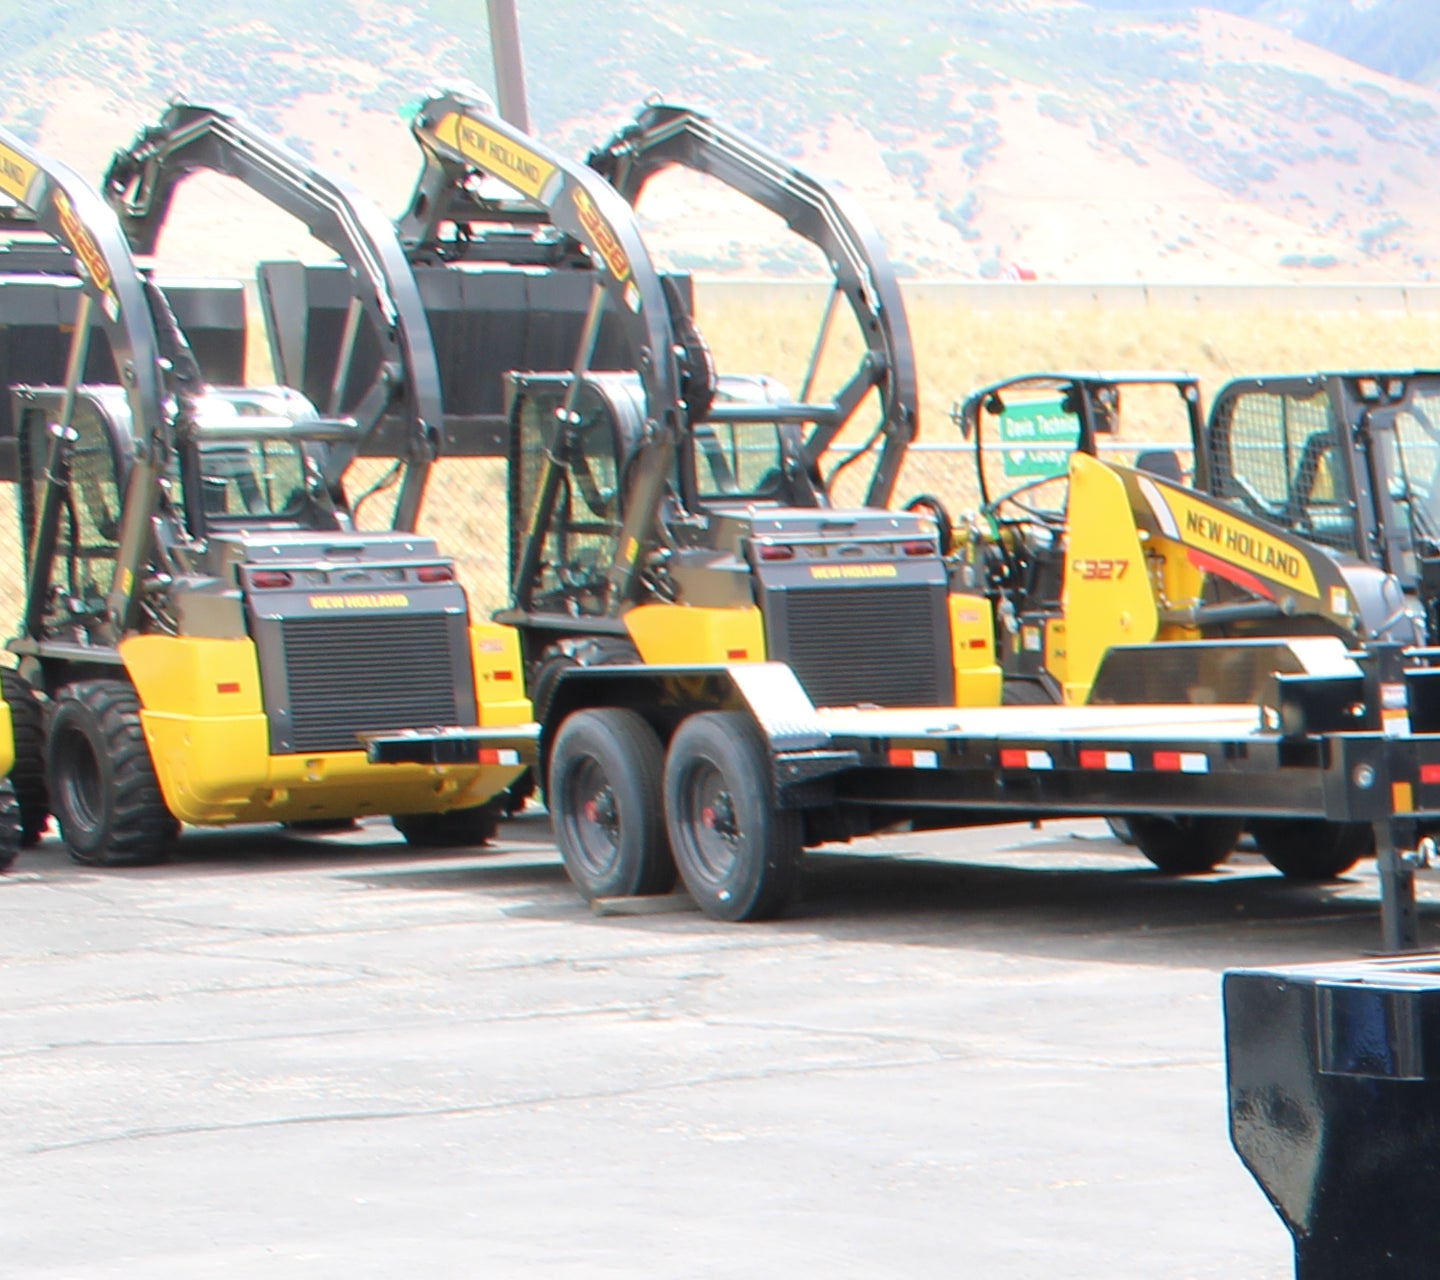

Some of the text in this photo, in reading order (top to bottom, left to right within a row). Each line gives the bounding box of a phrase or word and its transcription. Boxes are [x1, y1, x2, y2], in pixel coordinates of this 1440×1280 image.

[461, 124, 540, 185] NEW HOLLAND
[1185, 509, 1301, 579] NEW HOLLAND
[809, 563, 898, 580] NEW HOLLAND
[309, 594, 410, 609] NEW HOLLAND
